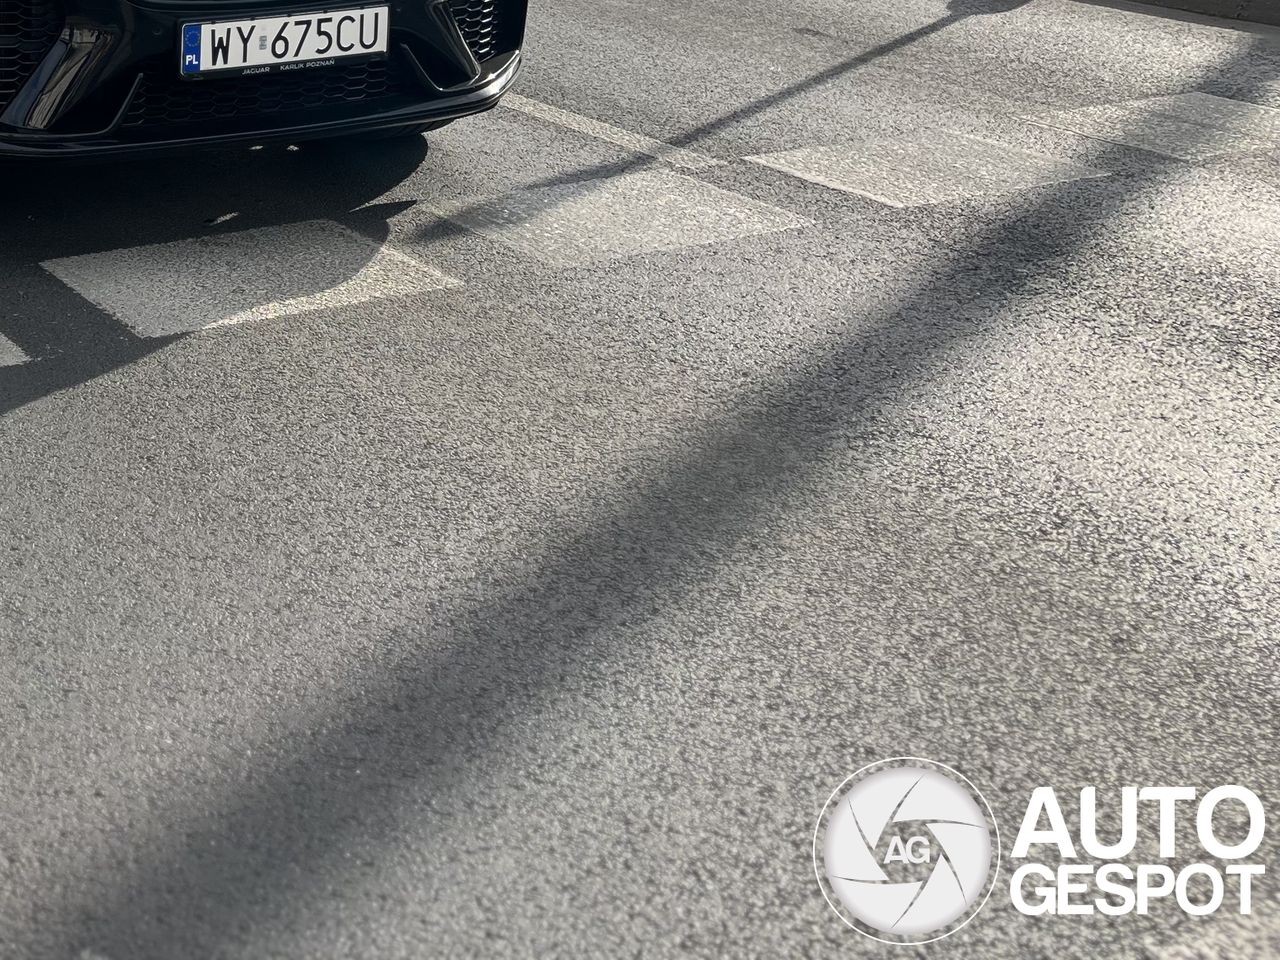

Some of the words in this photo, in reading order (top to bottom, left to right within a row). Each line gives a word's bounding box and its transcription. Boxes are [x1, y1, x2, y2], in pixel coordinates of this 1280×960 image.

[211, 25, 255, 66] WY
[271, 13, 379, 58] 675CU
[185, 54, 199, 66] PL
[242, 66, 270, 75] JAGUAR
[279, 62, 305, 71] KARLIK
